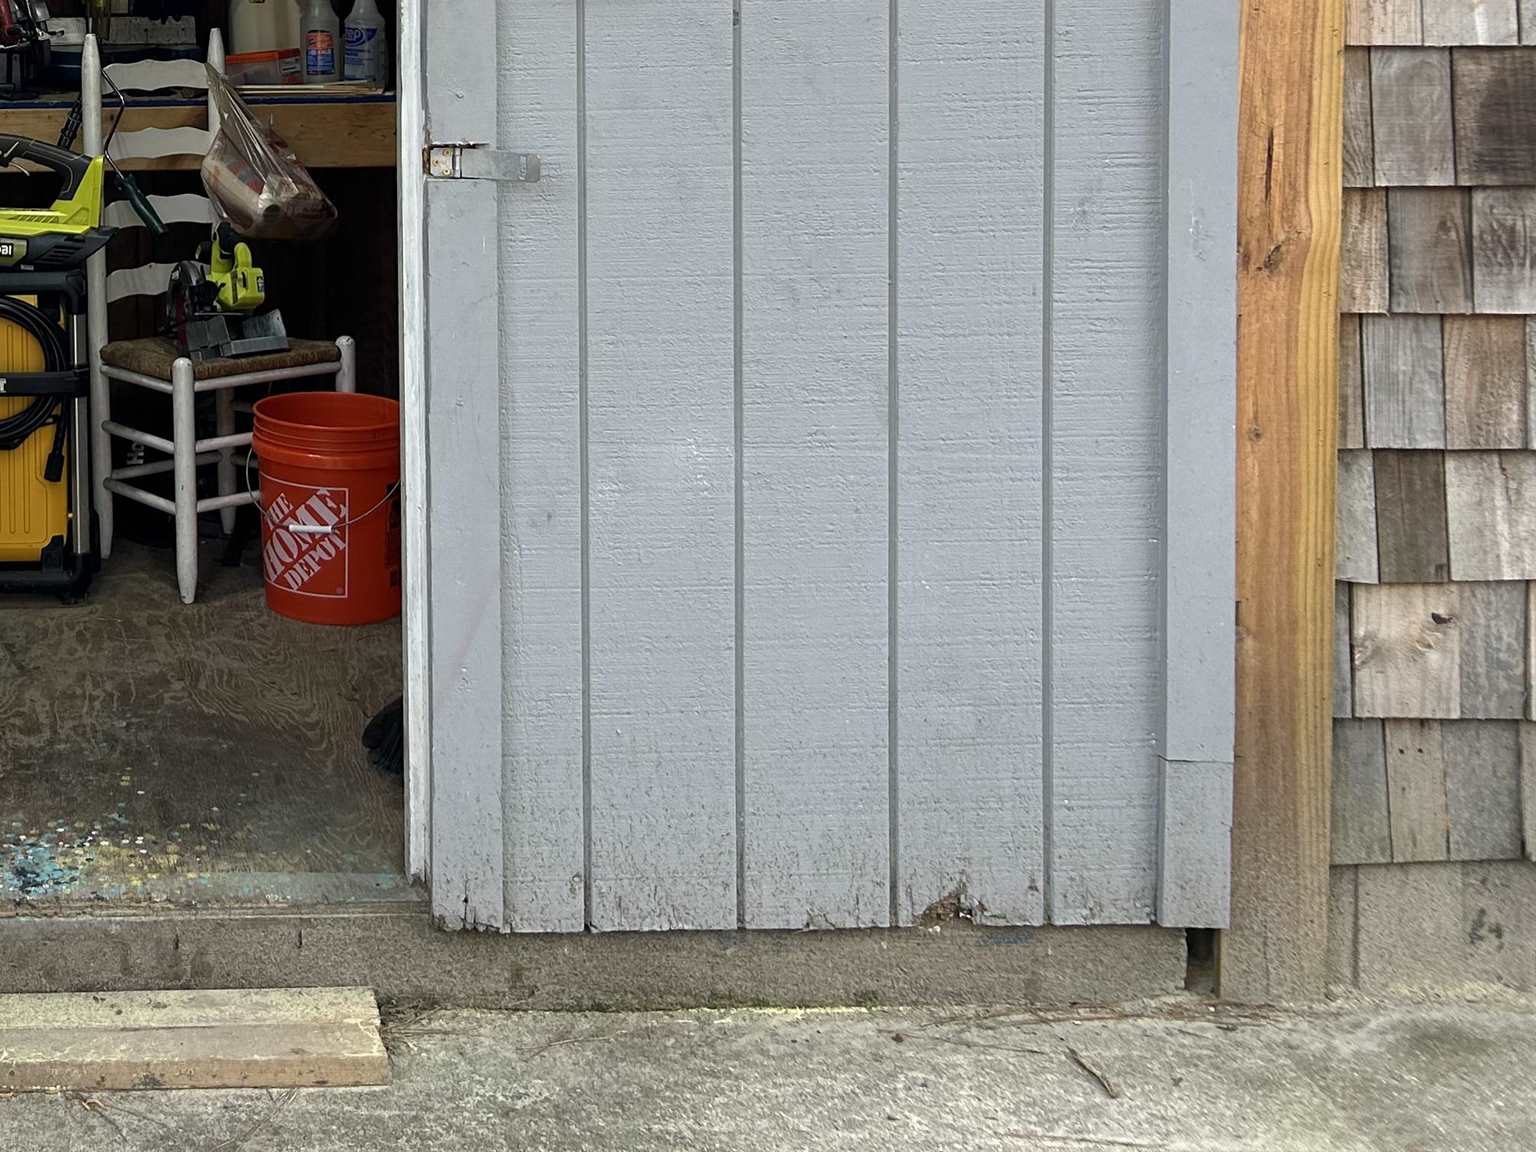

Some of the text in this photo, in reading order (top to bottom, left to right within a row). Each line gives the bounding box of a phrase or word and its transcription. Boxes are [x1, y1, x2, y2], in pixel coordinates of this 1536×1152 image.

[263, 487, 347, 583] HOME
[266, 492, 294, 531] THE
[283, 529, 347, 592] DEPOT
